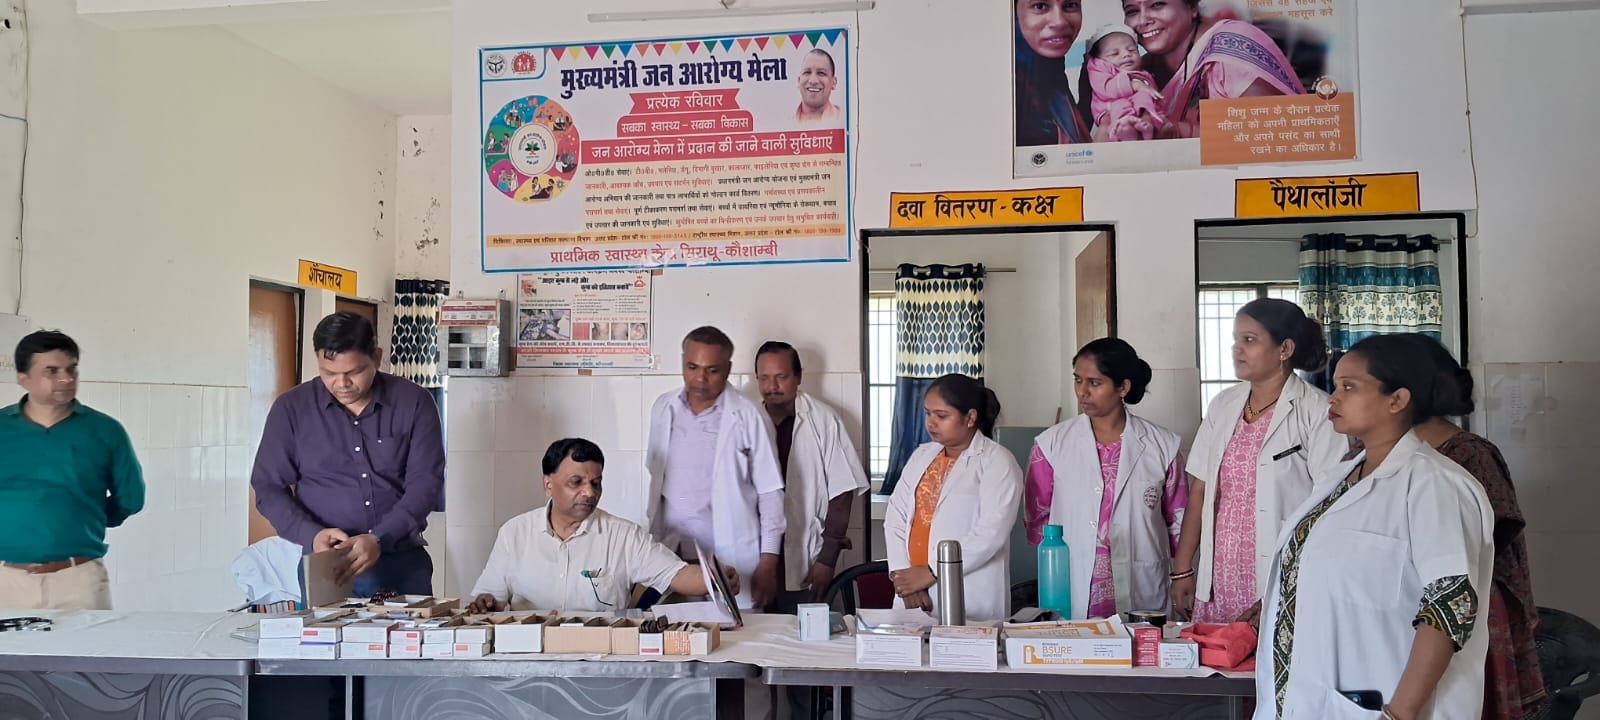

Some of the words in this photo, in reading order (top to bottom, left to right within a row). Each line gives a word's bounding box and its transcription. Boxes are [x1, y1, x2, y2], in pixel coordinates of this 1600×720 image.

[1288, 9, 1314, 20] महसूस
[560, 59, 638, 98] मुख्यमंत्री
[642, 64, 674, 86] जन
[679, 56, 743, 84] आरोग्य
[748, 53, 788, 82] मेला
[646, 92, 680, 110] प्रत्येक
[686, 92, 724, 107] रविवार
[1228, 106, 1246, 120] शिशु
[1250, 107, 1268, 116] जन्म
[1274, 104, 1282, 115] के
[1287, 104, 1310, 115] दौरान
[1314, 103, 1340, 113] प्रत्येक
[651, 120, 680, 132] स्वास्थ्य
[721, 116, 748, 128] विकास
[1217, 120, 1243, 132] महिला
[1248, 119, 1259, 129] को
[1264, 118, 1287, 128] अपनी
[1234, 132, 1249, 142] और
[1254, 131, 1274, 142] अपने
[1279, 130, 1298, 140] पसंद
[1320, 128, 1340, 138] साथी
[592, 144, 610, 158] जन
[614, 140, 650, 157] आरोग्य
[652, 139, 674, 155] मेला
[677, 137, 686, 154] में
[688, 140, 714, 154] प्रदान
[719, 136, 732, 153] की
[736, 135, 758, 152] जाने
[762, 133, 787, 151] वाली
[790, 131, 833, 155] सुविधाएं
[1250, 144, 1271, 154] रखने
[1292, 142, 1325, 152] अधिकार
[1270, 177, 1367, 212] पैथालॉजी
[898, 200, 926, 220] दवा
[934, 195, 998, 220] वितरण
[1012, 196, 1061, 218] कक्ष
[550, 246, 600, 262] प्राथमिक
[1042, 646, 1072, 655] BSURE
